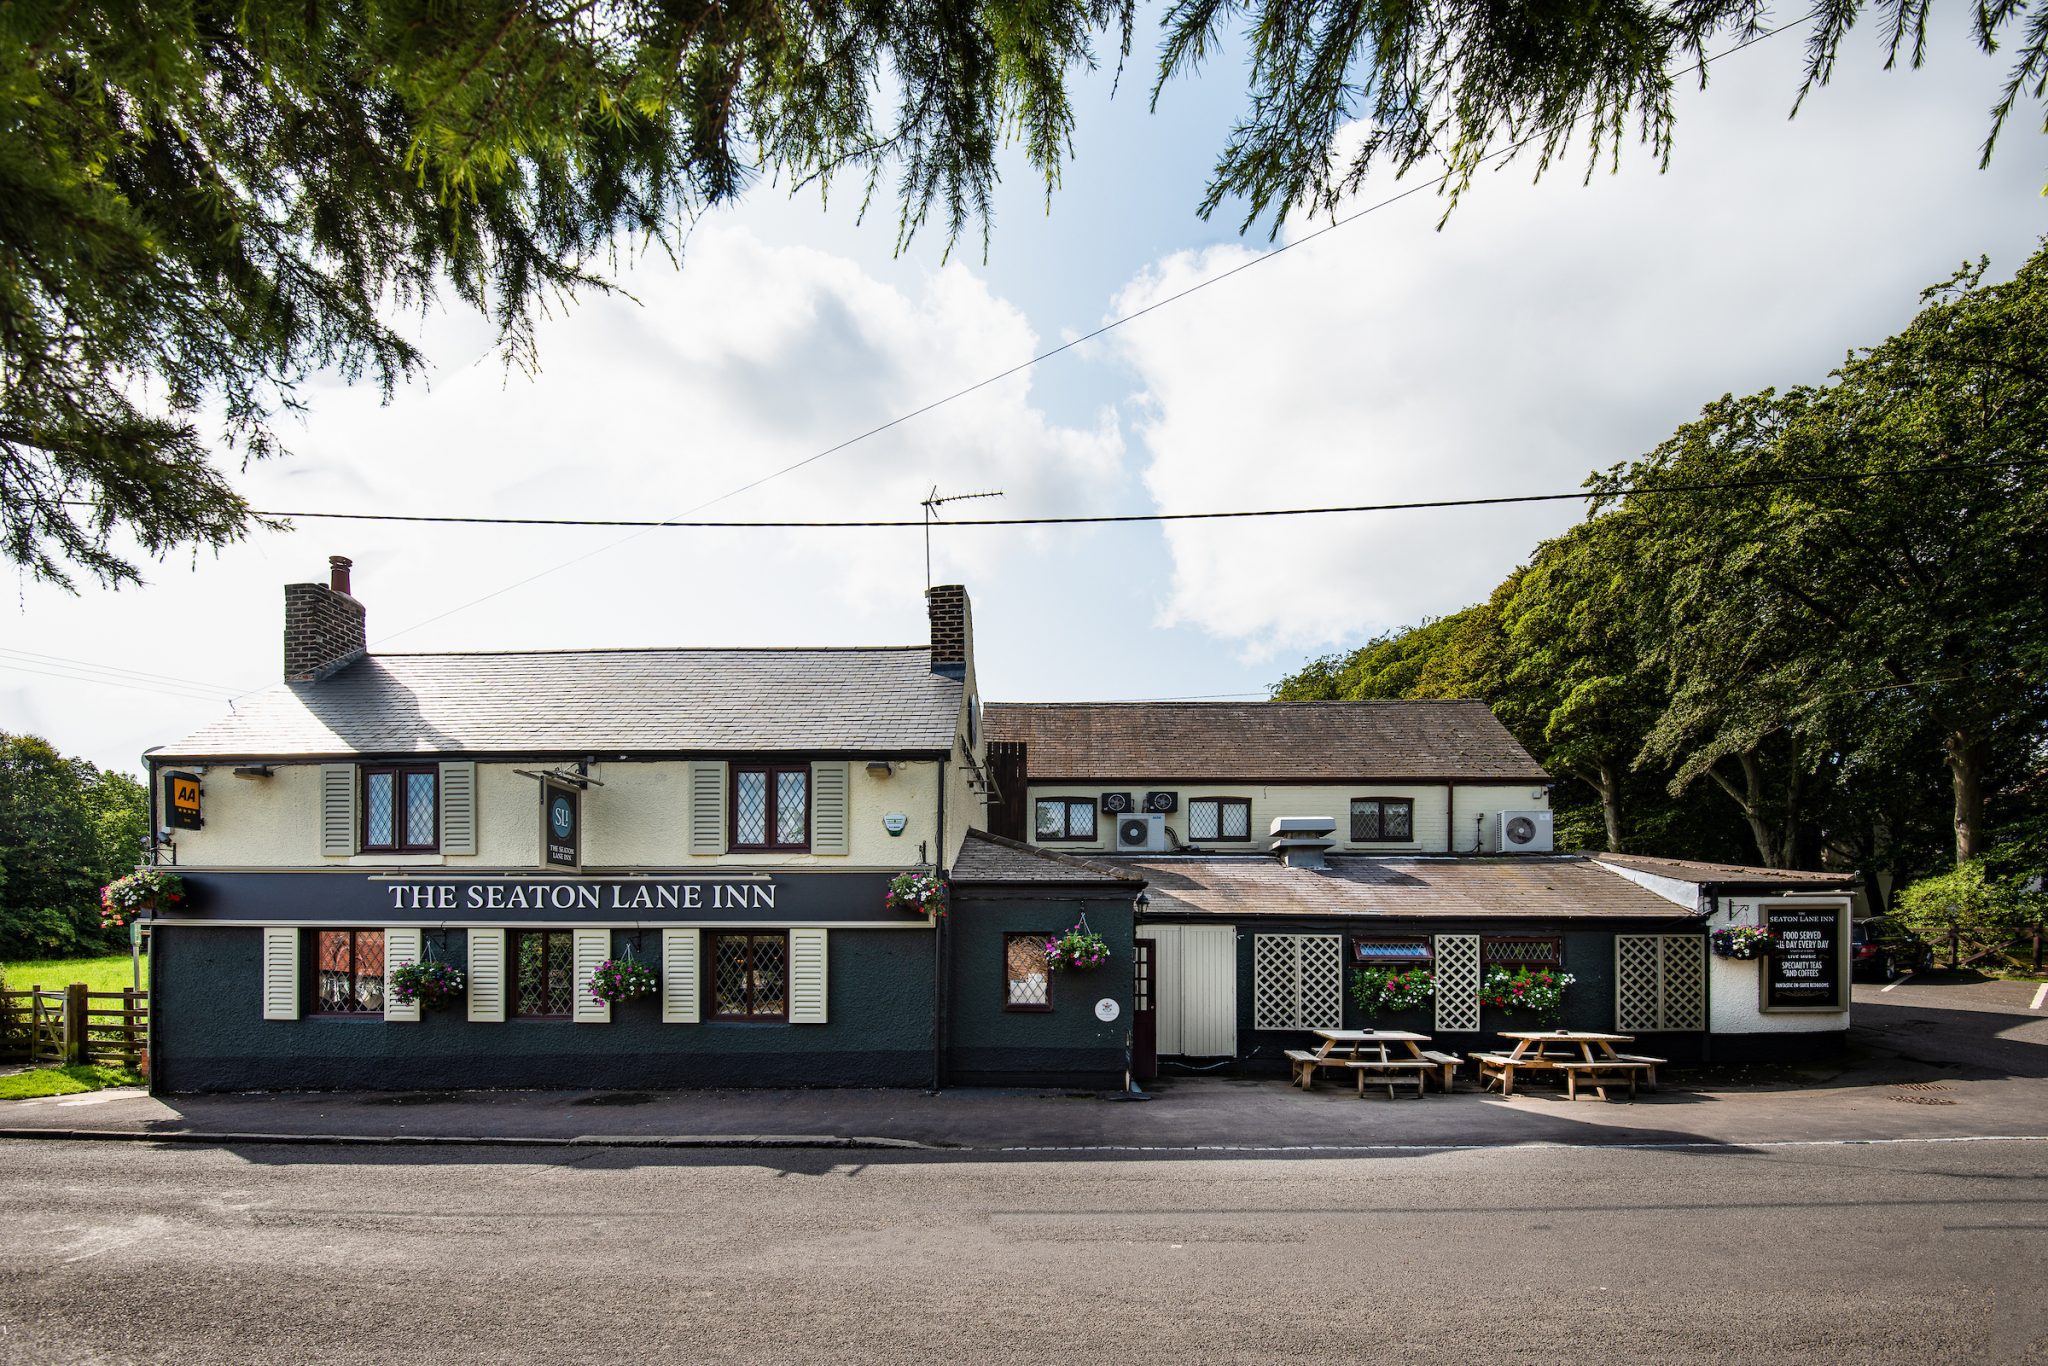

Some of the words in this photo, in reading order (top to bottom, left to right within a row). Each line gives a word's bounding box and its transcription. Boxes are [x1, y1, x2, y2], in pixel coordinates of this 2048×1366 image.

[178, 786, 195, 802] AA
[559, 846, 574, 854] SEATON
[388, 884, 457, 909] THE
[466, 884, 600, 909] SEATON
[611, 884, 703, 909] LANE
[712, 884, 777, 909] INN
[1783, 931, 1798, 940] FOOD
[1800, 931, 1821, 940] SERVED
[1786, 941, 1798, 949] DAY
[1798, 941, 1817, 949] EVERY
[1817, 941, 1829, 949] DAY
[1782, 961, 1809, 969] SPECIALITY
[1810, 961, 1822, 969] TEAS
[1785, 969, 1797, 977] AND
[1798, 969, 1819, 977] COFFEES
